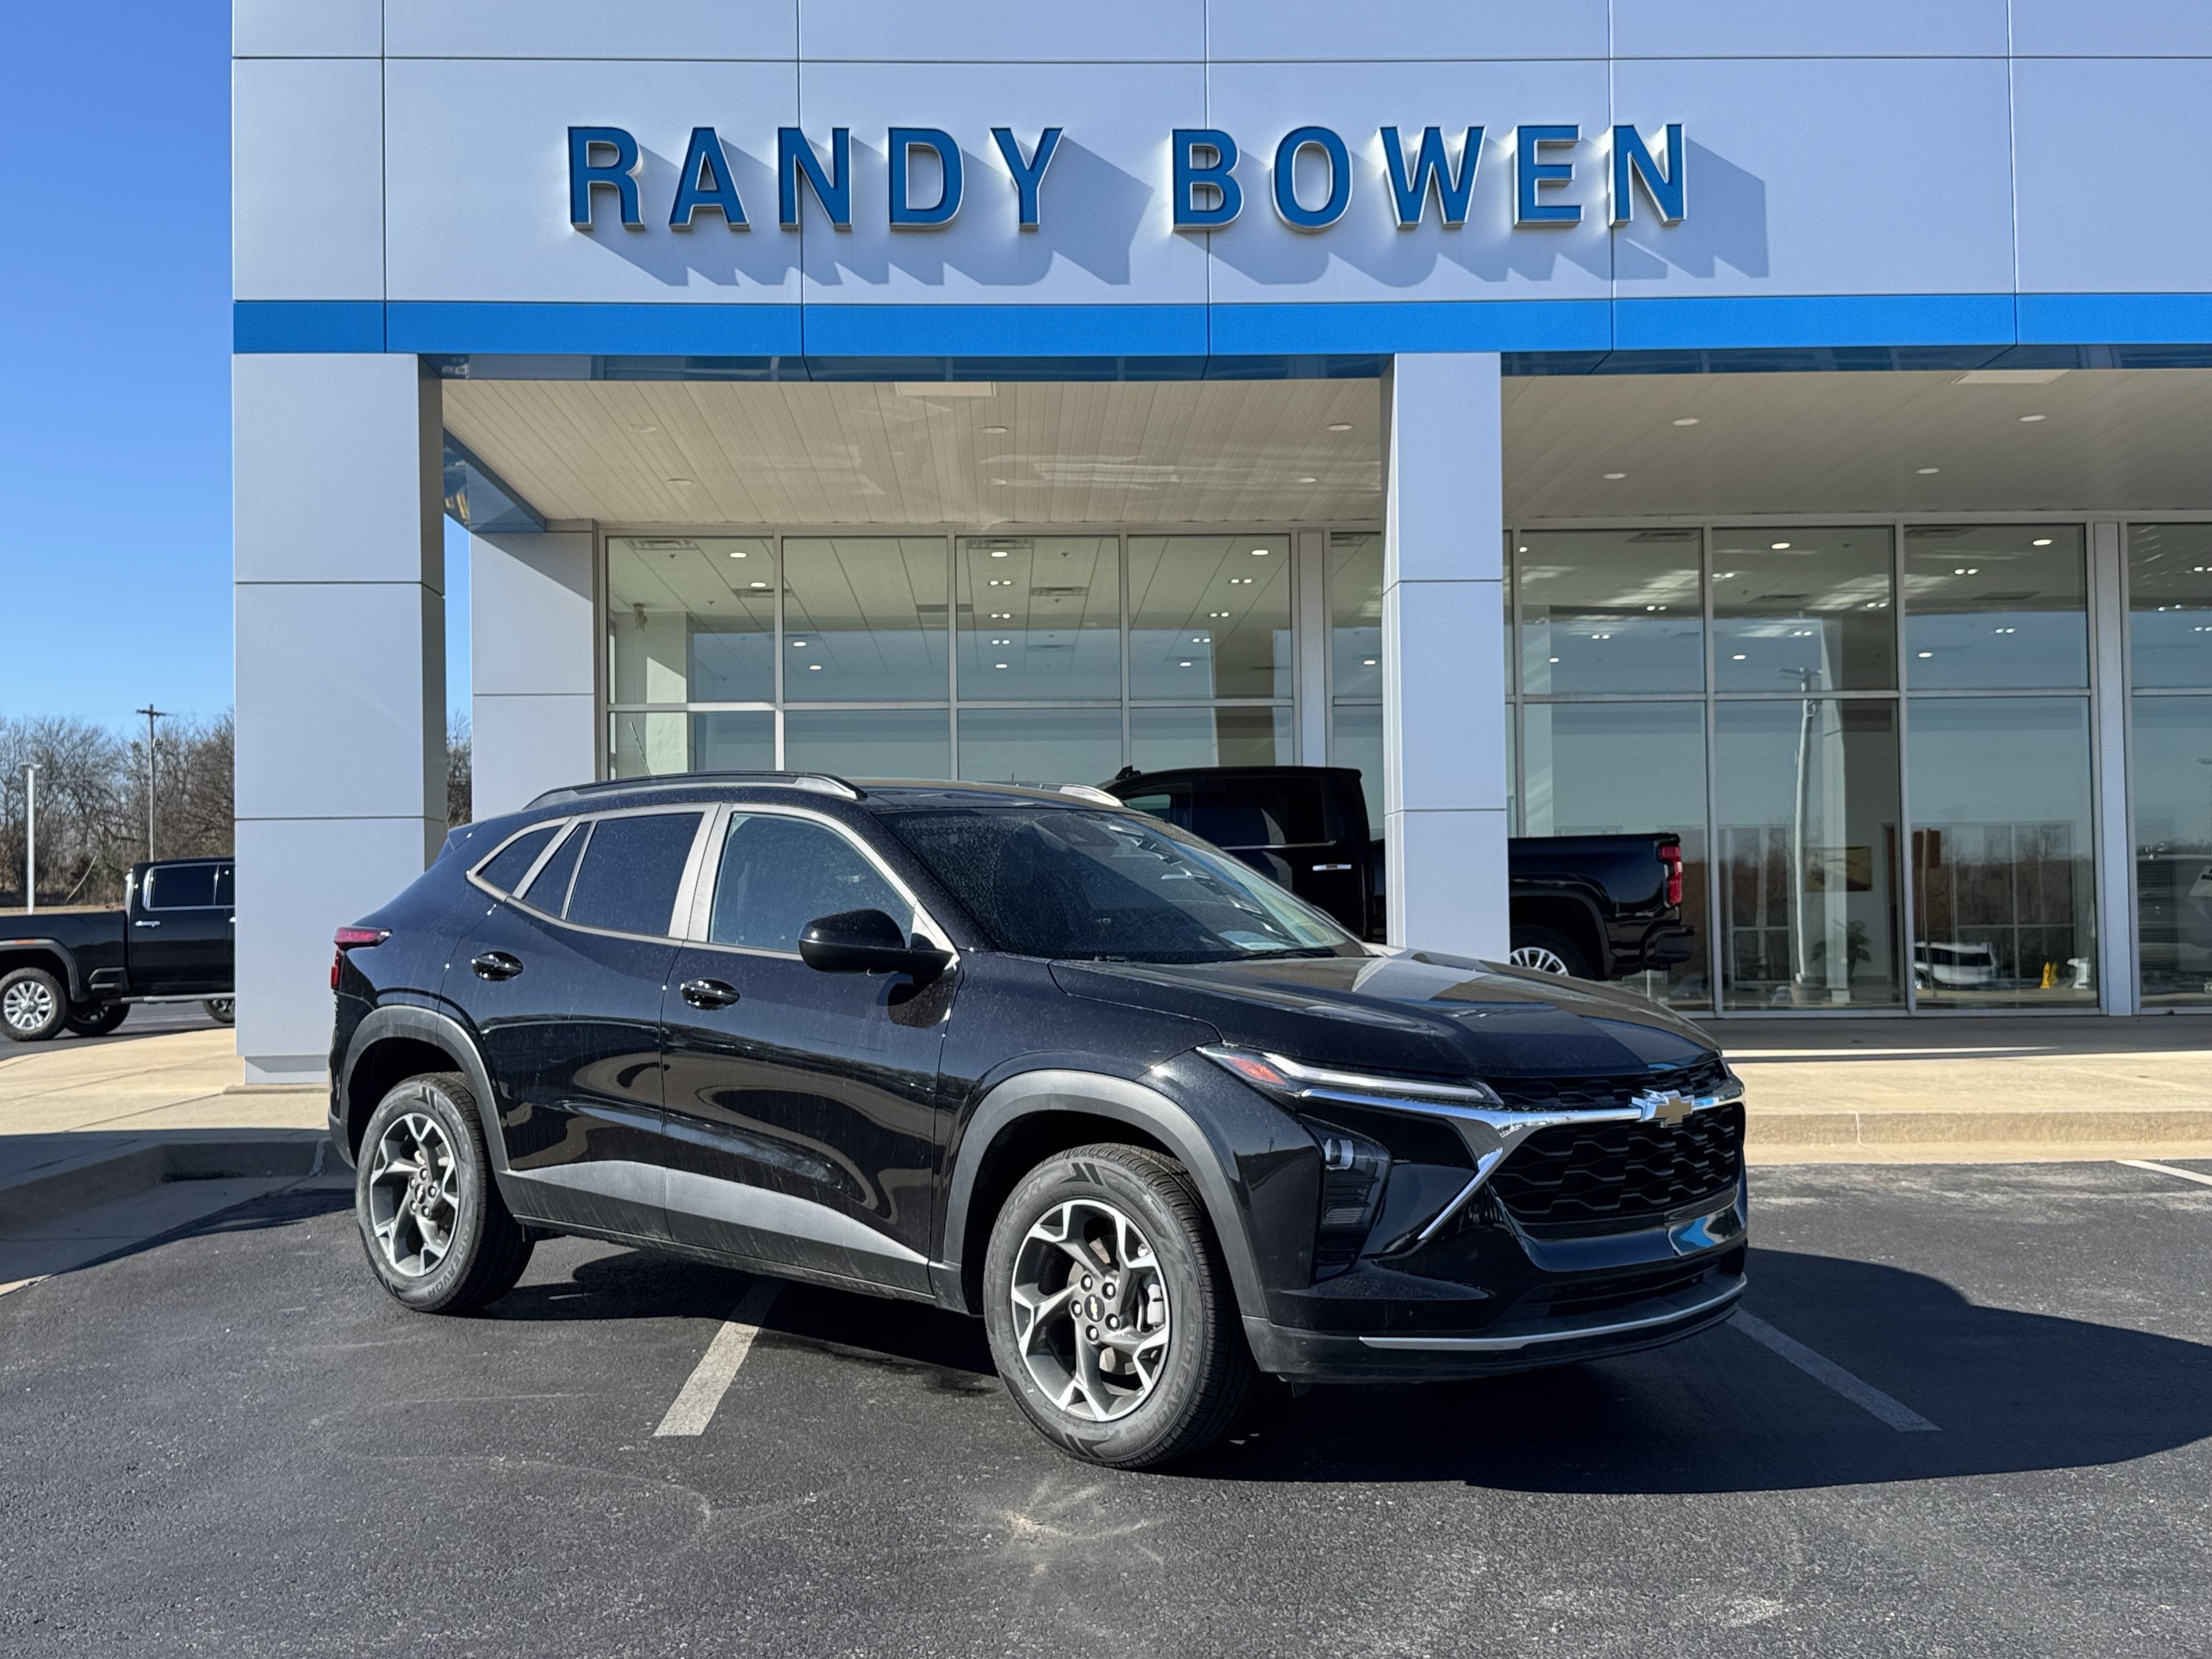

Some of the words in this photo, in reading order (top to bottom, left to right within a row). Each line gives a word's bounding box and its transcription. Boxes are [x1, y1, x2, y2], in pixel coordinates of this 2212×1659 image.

[567, 127, 1064, 231] RANDY
[1172, 124, 1686, 231] BOWEN
[1146, 1306, 1194, 1438] ENDEAVOR
